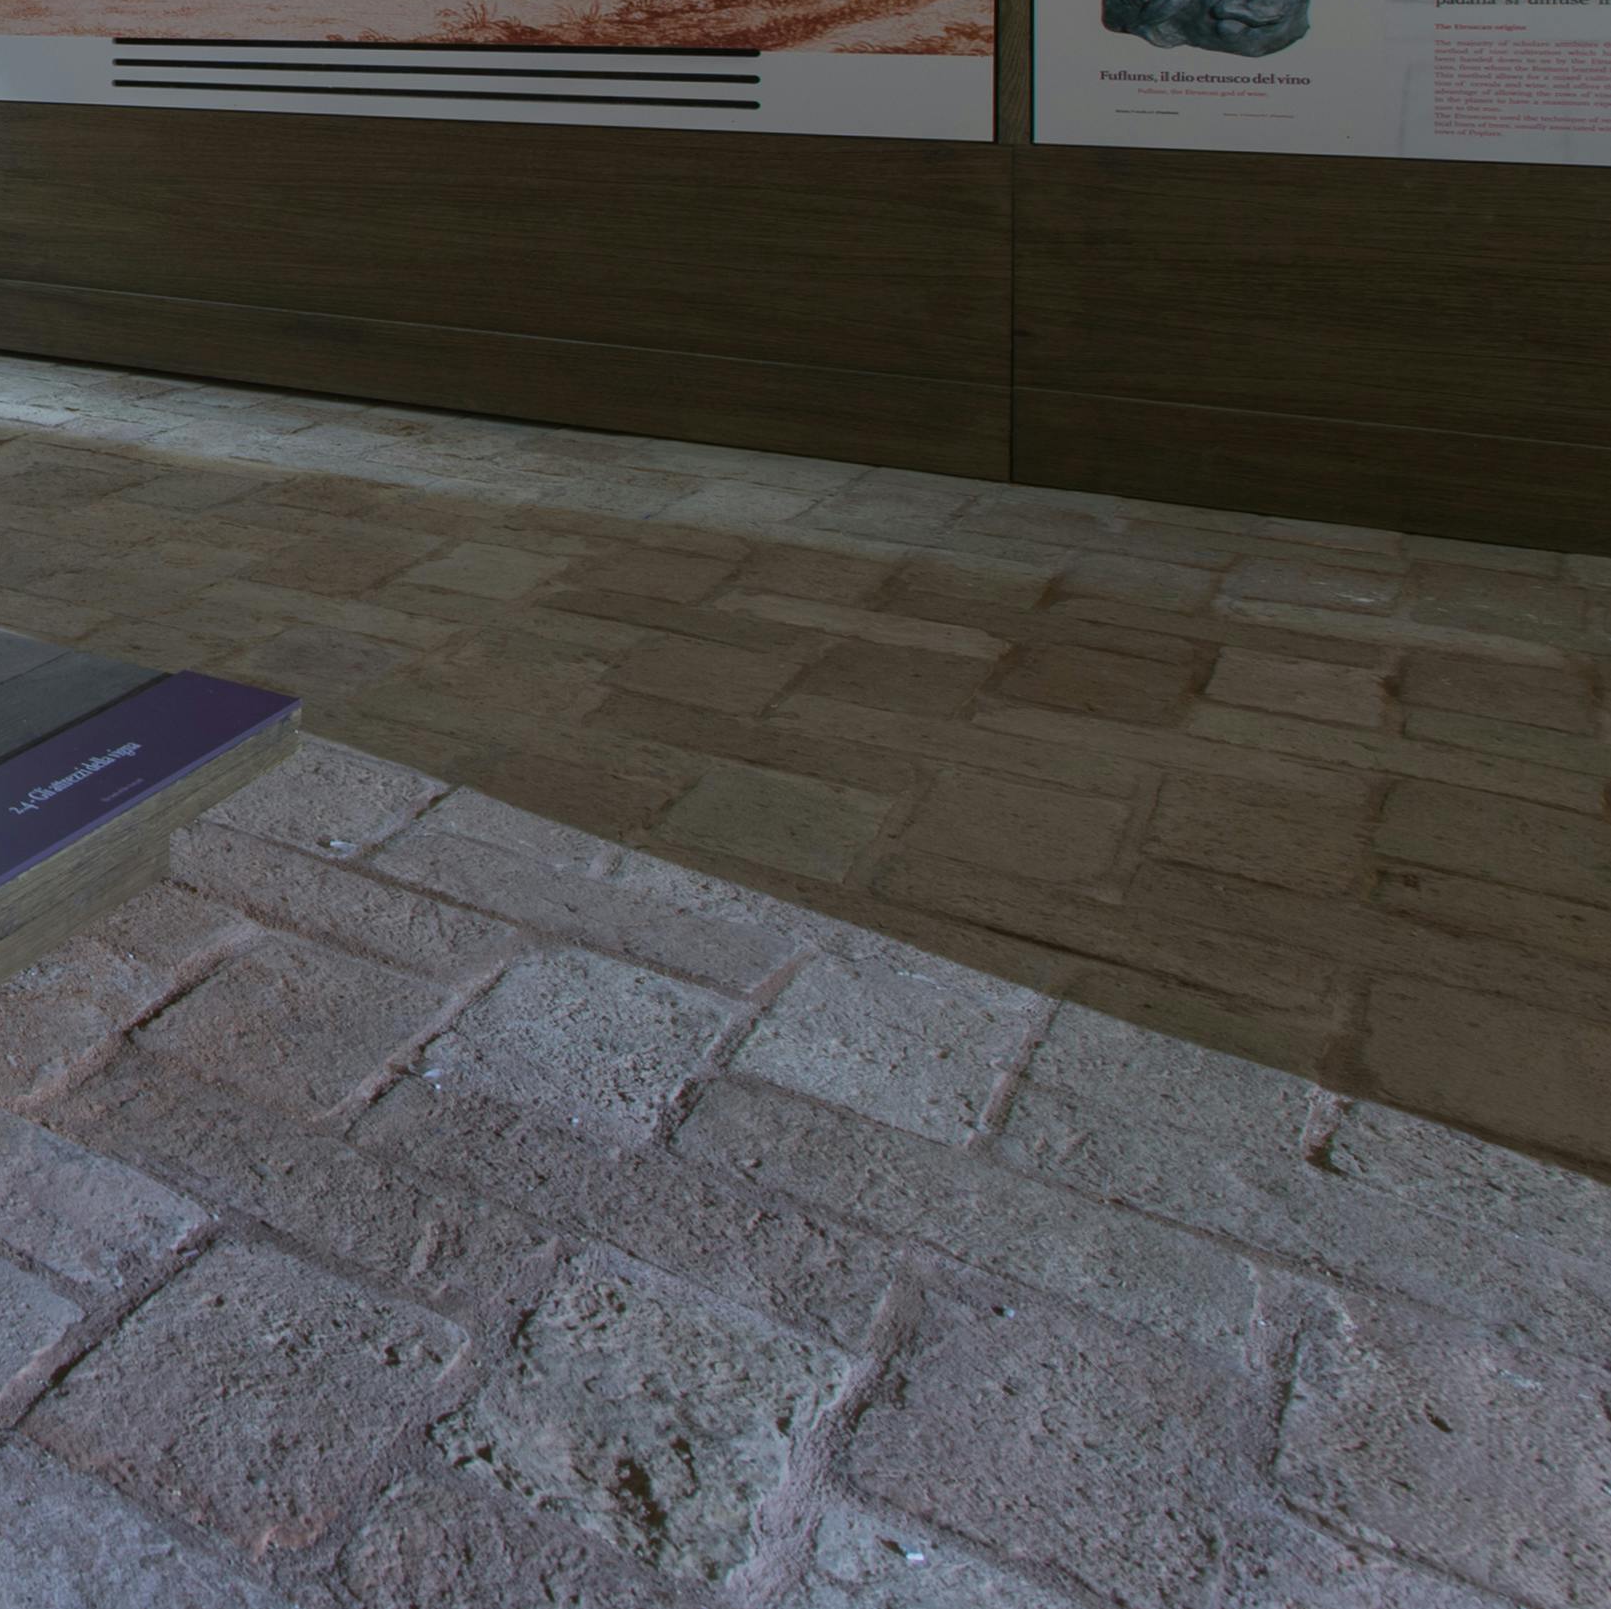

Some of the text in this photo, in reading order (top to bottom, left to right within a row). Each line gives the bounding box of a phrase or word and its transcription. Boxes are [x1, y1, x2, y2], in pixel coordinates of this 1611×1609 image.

[1100, 70, 1310, 85] Fufluns, il dio etrusco del vino
